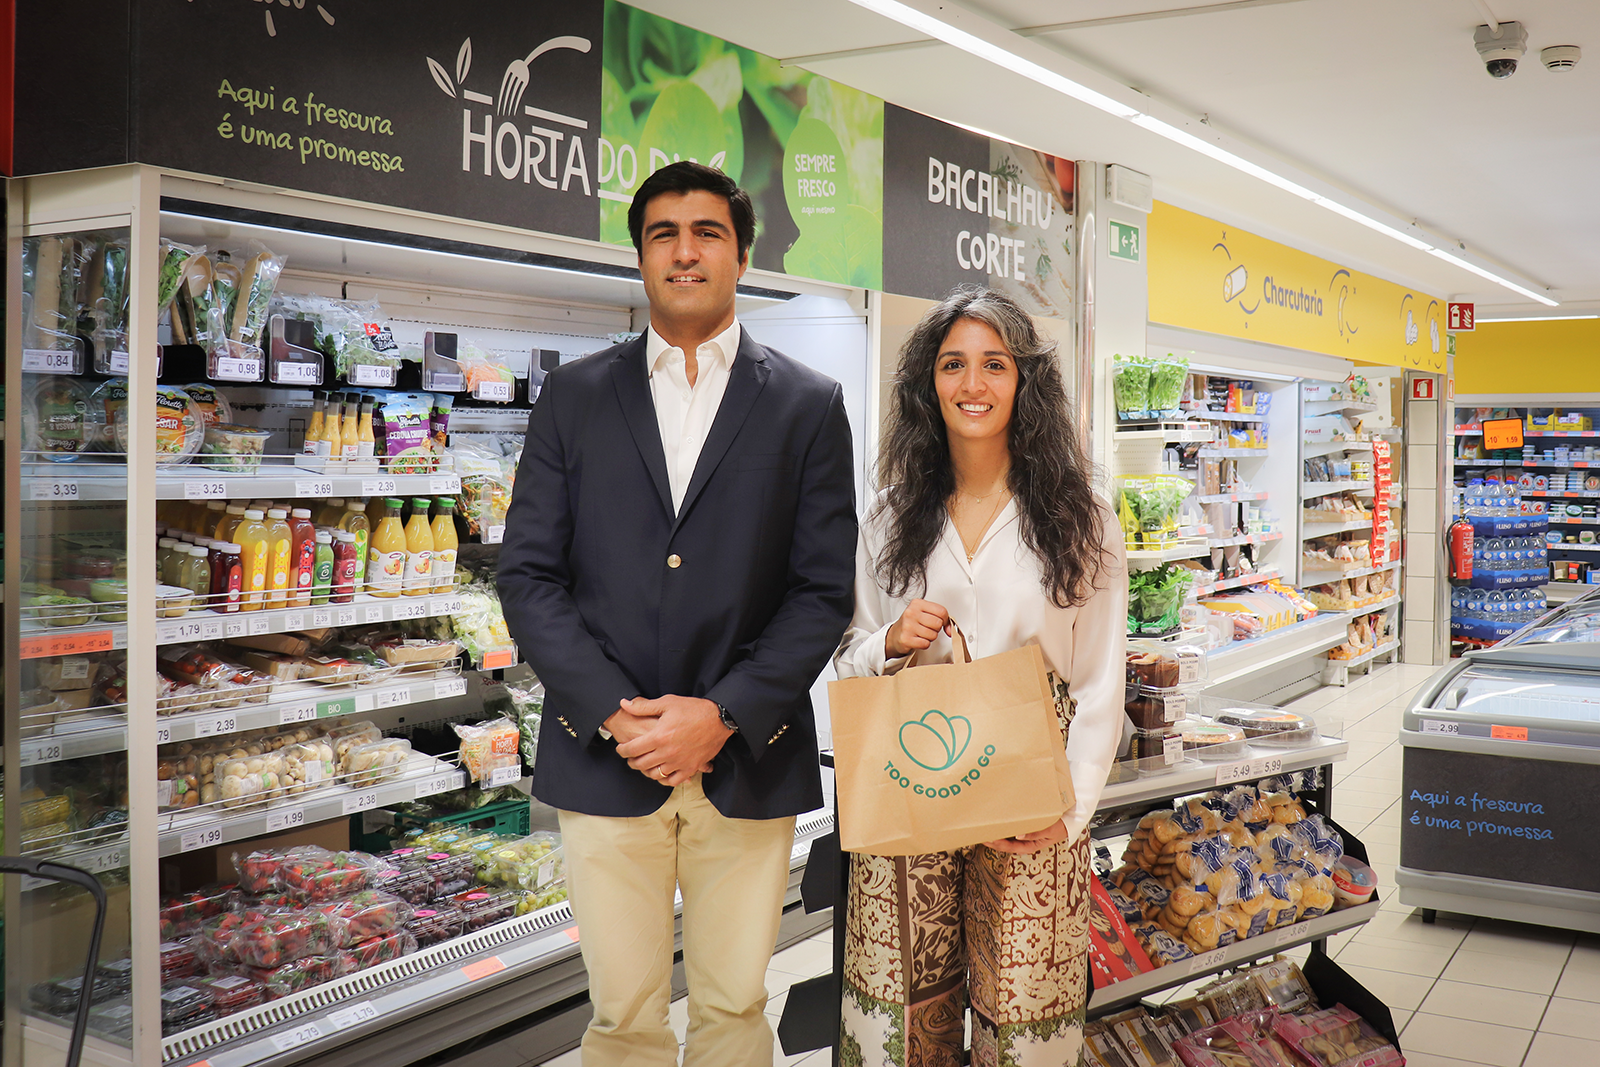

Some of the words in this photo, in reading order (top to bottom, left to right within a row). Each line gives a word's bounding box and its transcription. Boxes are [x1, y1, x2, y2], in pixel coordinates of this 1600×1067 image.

[218, 79, 275, 115] Aqui
[282, 97, 299, 115] a
[304, 92, 394, 136] frescura
[217, 113, 234, 139] é
[241, 124, 294, 150] uma
[299, 135, 405, 173] promessa
[462, 109, 591, 196] HORTA
[598, 137, 637, 189] DO
[795, 154, 836, 173] SEMPRE
[797, 178, 836, 198] FRESCO
[928, 157, 1052, 230] BACALHAU
[956, 230, 1026, 282] CORTE
[1263, 276, 1323, 317] Charcutaria
[46, 355, 69, 368] 0,84
[238, 363, 256, 376] 0,98
[297, 366, 317, 378] 1,08
[374, 368, 390, 379] 1,08
[53, 483, 78, 497] 3,39
[203, 483, 225, 496] 3,25
[314, 484, 331, 495] 3,69
[378, 481, 394, 493] 2,39
[445, 480, 460, 491] 1,49
[407, 605, 425, 617] 3,25
[444, 600, 461, 613] 3,40
[179, 624, 200, 637] 1,79
[448, 681, 464, 693] 1,39
[391, 691, 408, 703] 2,11
[298, 707, 315, 720] 2,11
[327, 703, 341, 714] BIO
[216, 719, 235, 732] 2,39
[1440, 723, 1459, 734] 2,99
[37, 747, 60, 762] 1,28
[883, 760, 910, 788] TOO
[913, 783, 962, 799] GOOD
[960, 768, 981, 787] TO
[977, 744, 996, 767] GO
[1232, 765, 1251, 779] 5,49
[1264, 759, 1282, 773] 5,99
[430, 779, 446, 792] 1,99
[358, 794, 376, 808] 2,38
[1410, 789, 1449, 808] Aqui
[1455, 794, 1467, 806] a
[1471, 792, 1545, 815] frescura
[284, 811, 303, 825] 1,99
[1410, 810, 1421, 825] é
[1425, 815, 1462, 830] uma
[1466, 819, 1554, 840] promessa
[199, 830, 221, 844] 1,99
[96, 853, 120, 867] 1,19
[1290, 923, 1308, 937] 3,66
[1205, 951, 1225, 966] 3,66
[353, 1006, 375, 1022] 1,79
[298, 1026, 320, 1042] 2,79
